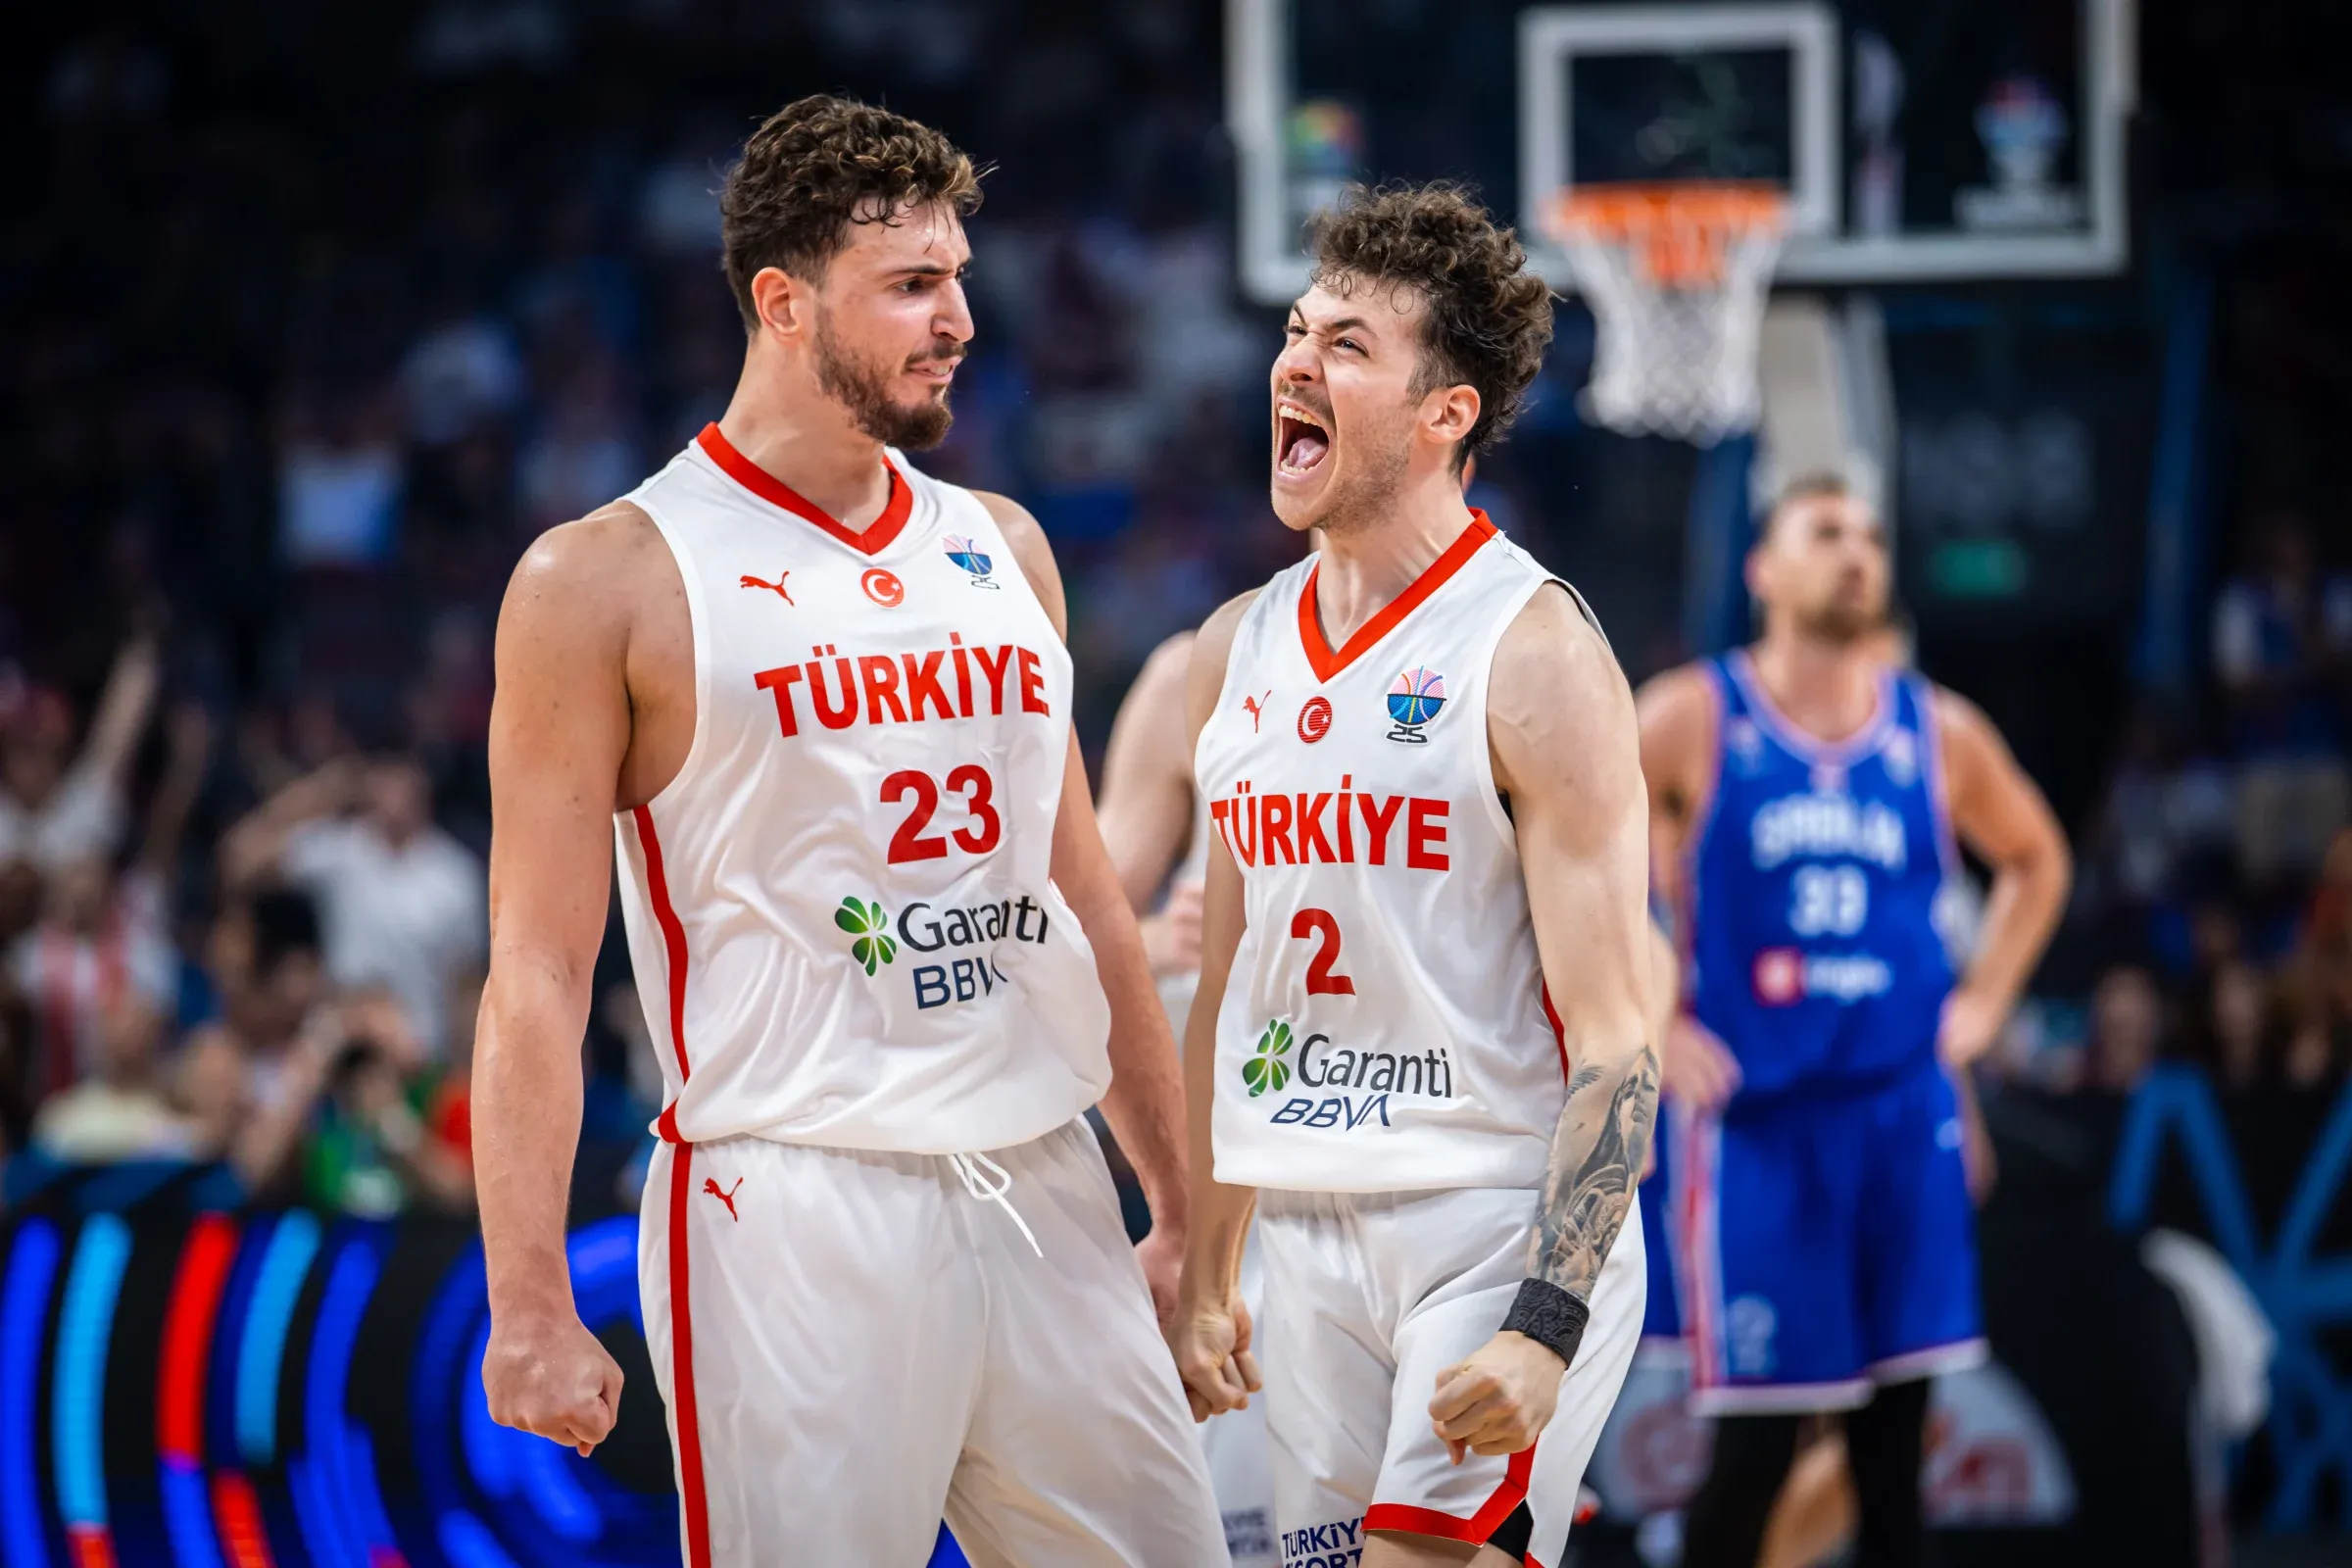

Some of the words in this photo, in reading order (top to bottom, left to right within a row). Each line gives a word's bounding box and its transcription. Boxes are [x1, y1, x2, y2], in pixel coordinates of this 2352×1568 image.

[754, 631, 1051, 738] TÜRKİYE
[879, 764, 1001, 864] 23
[1209, 774, 1450, 871] TÜRKİYE
[1290, 907, 1356, 997] 2
[1298, 1033, 1452, 1099] Garanti
[1269, 1093, 1391, 1132] BBVA
[1282, 1516, 1366, 1559] TÜRKİY
